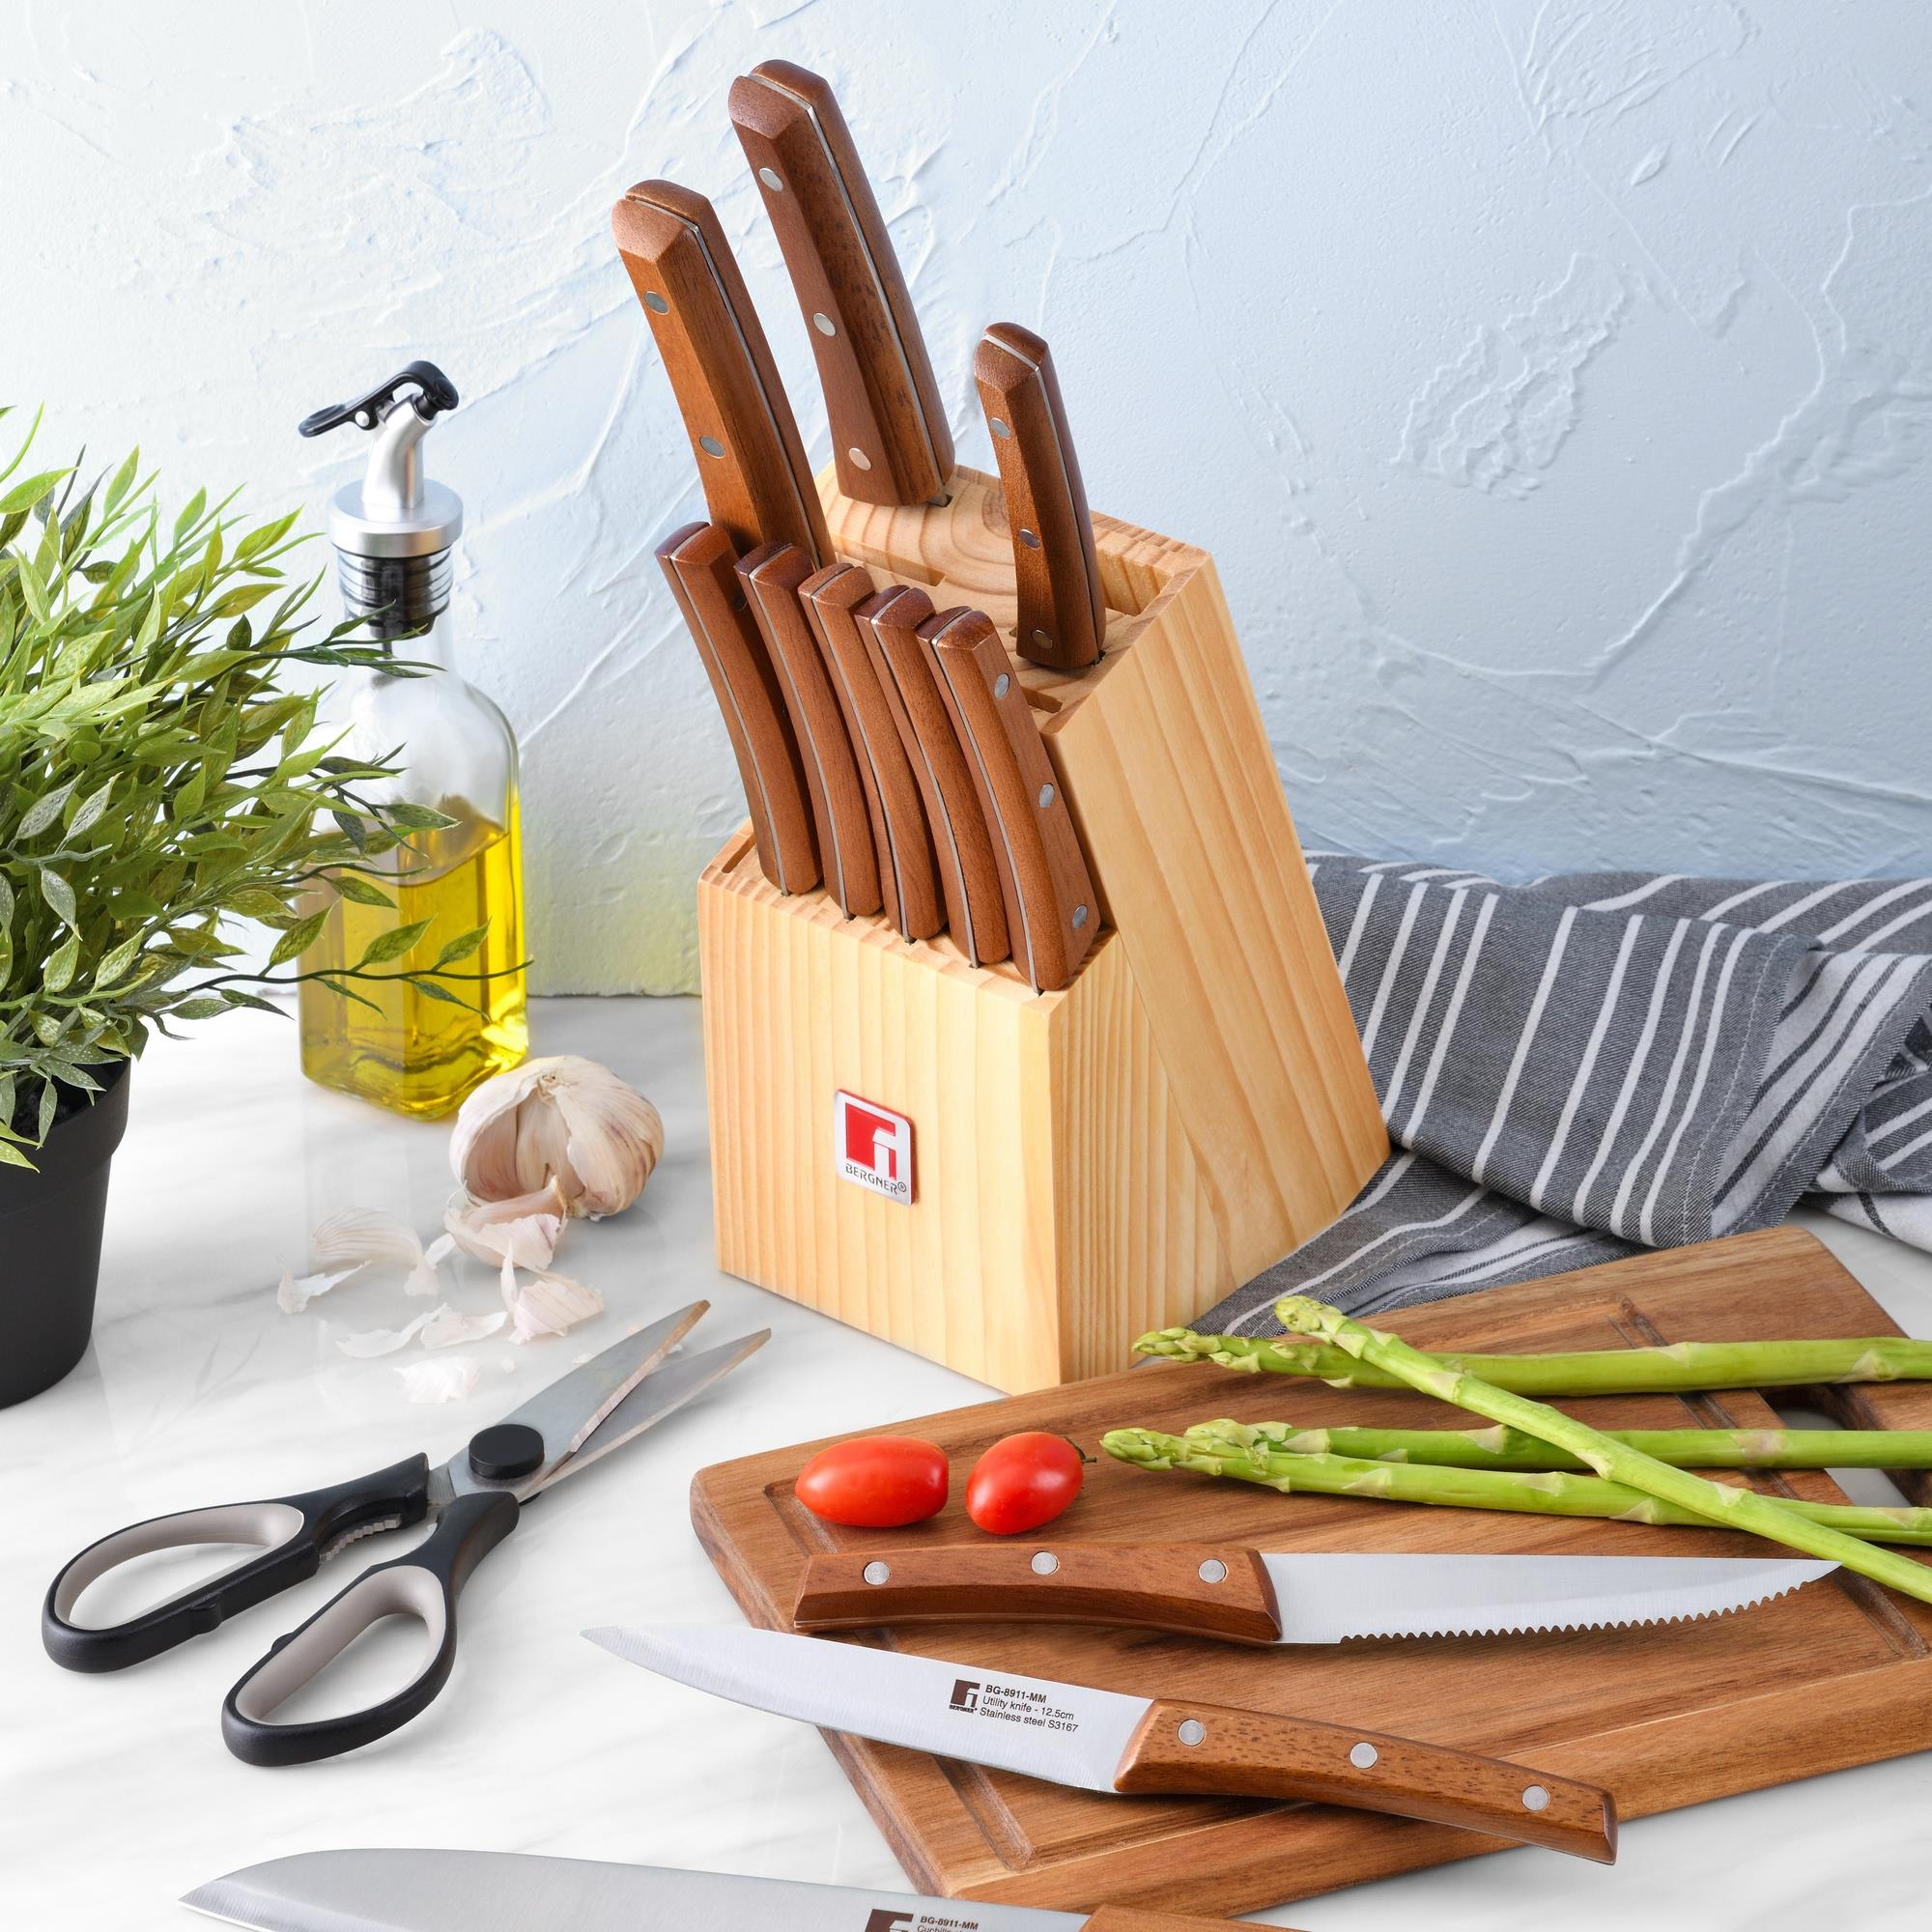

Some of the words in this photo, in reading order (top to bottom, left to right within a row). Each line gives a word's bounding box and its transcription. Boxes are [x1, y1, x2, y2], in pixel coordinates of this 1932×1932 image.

[985, 1684, 1047, 1704] BG-8911-MM
[982, 1695, 1009, 1710] Utility
[1009, 1700, 1033, 1713] knife
[1042, 1706, 1074, 1720] 12.5cm
[980, 1707, 1022, 1722] Stainless
[1023, 1717, 1046, 1727] steel
[1047, 1719, 1079, 1732] S3167
[921, 1916, 980, 1930] BG-8911-MM
